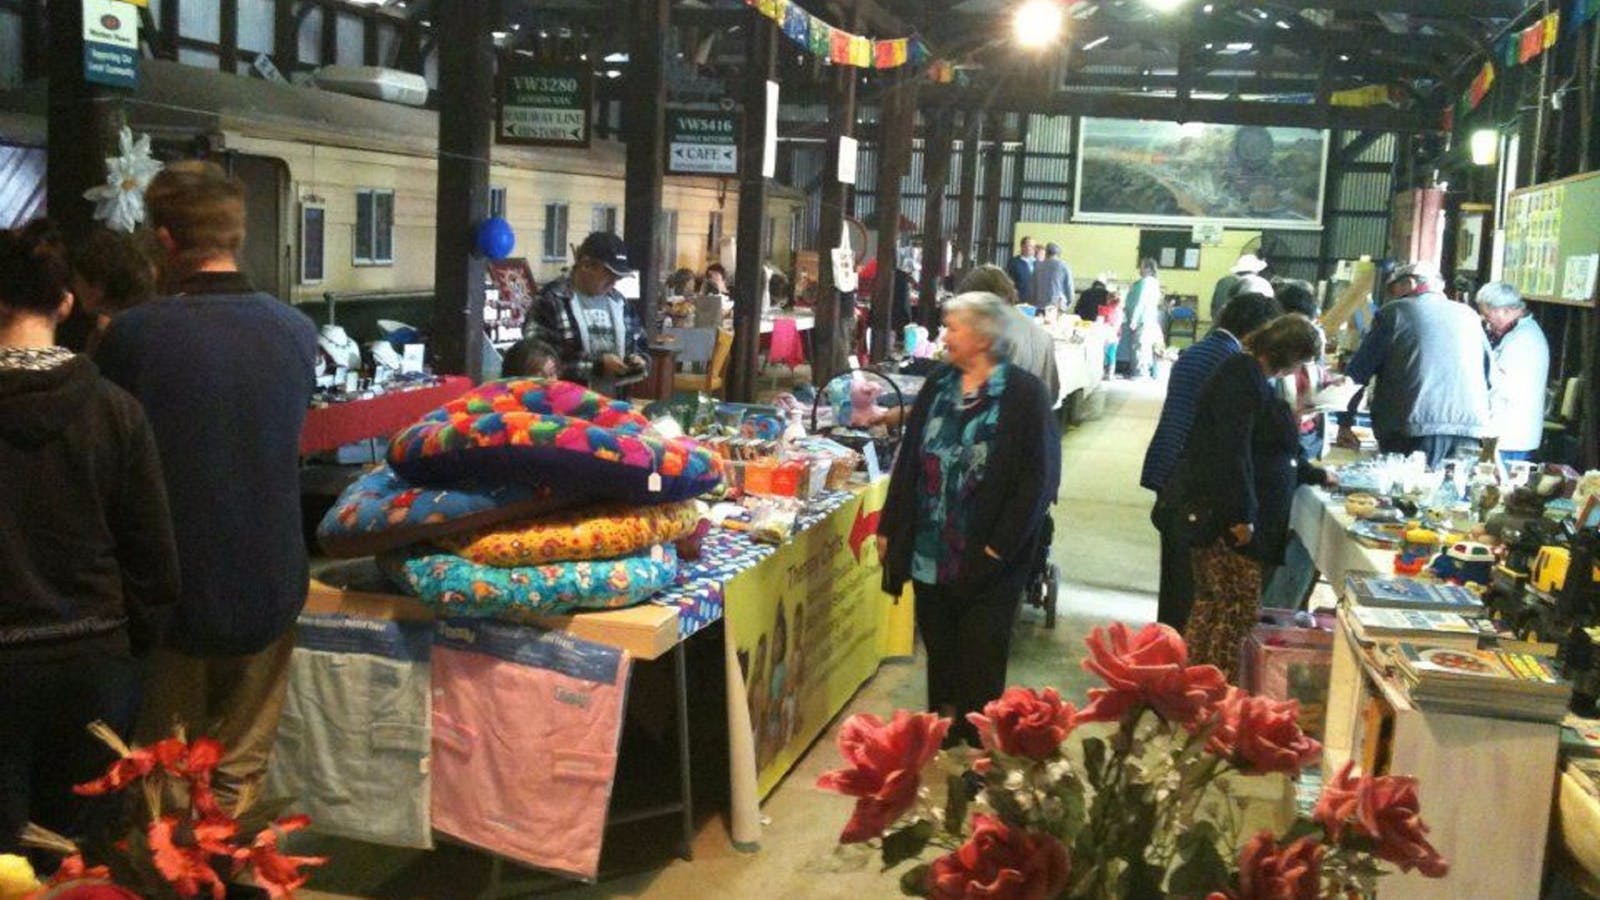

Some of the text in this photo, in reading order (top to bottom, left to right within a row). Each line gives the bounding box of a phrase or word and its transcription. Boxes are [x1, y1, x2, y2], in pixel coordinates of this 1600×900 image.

[512, 76, 578, 93] VW3280
[504, 110, 583, 125] RAILWAY LINE
[676, 117, 733, 132] VW5416
[687, 148, 721, 160] CAFE
